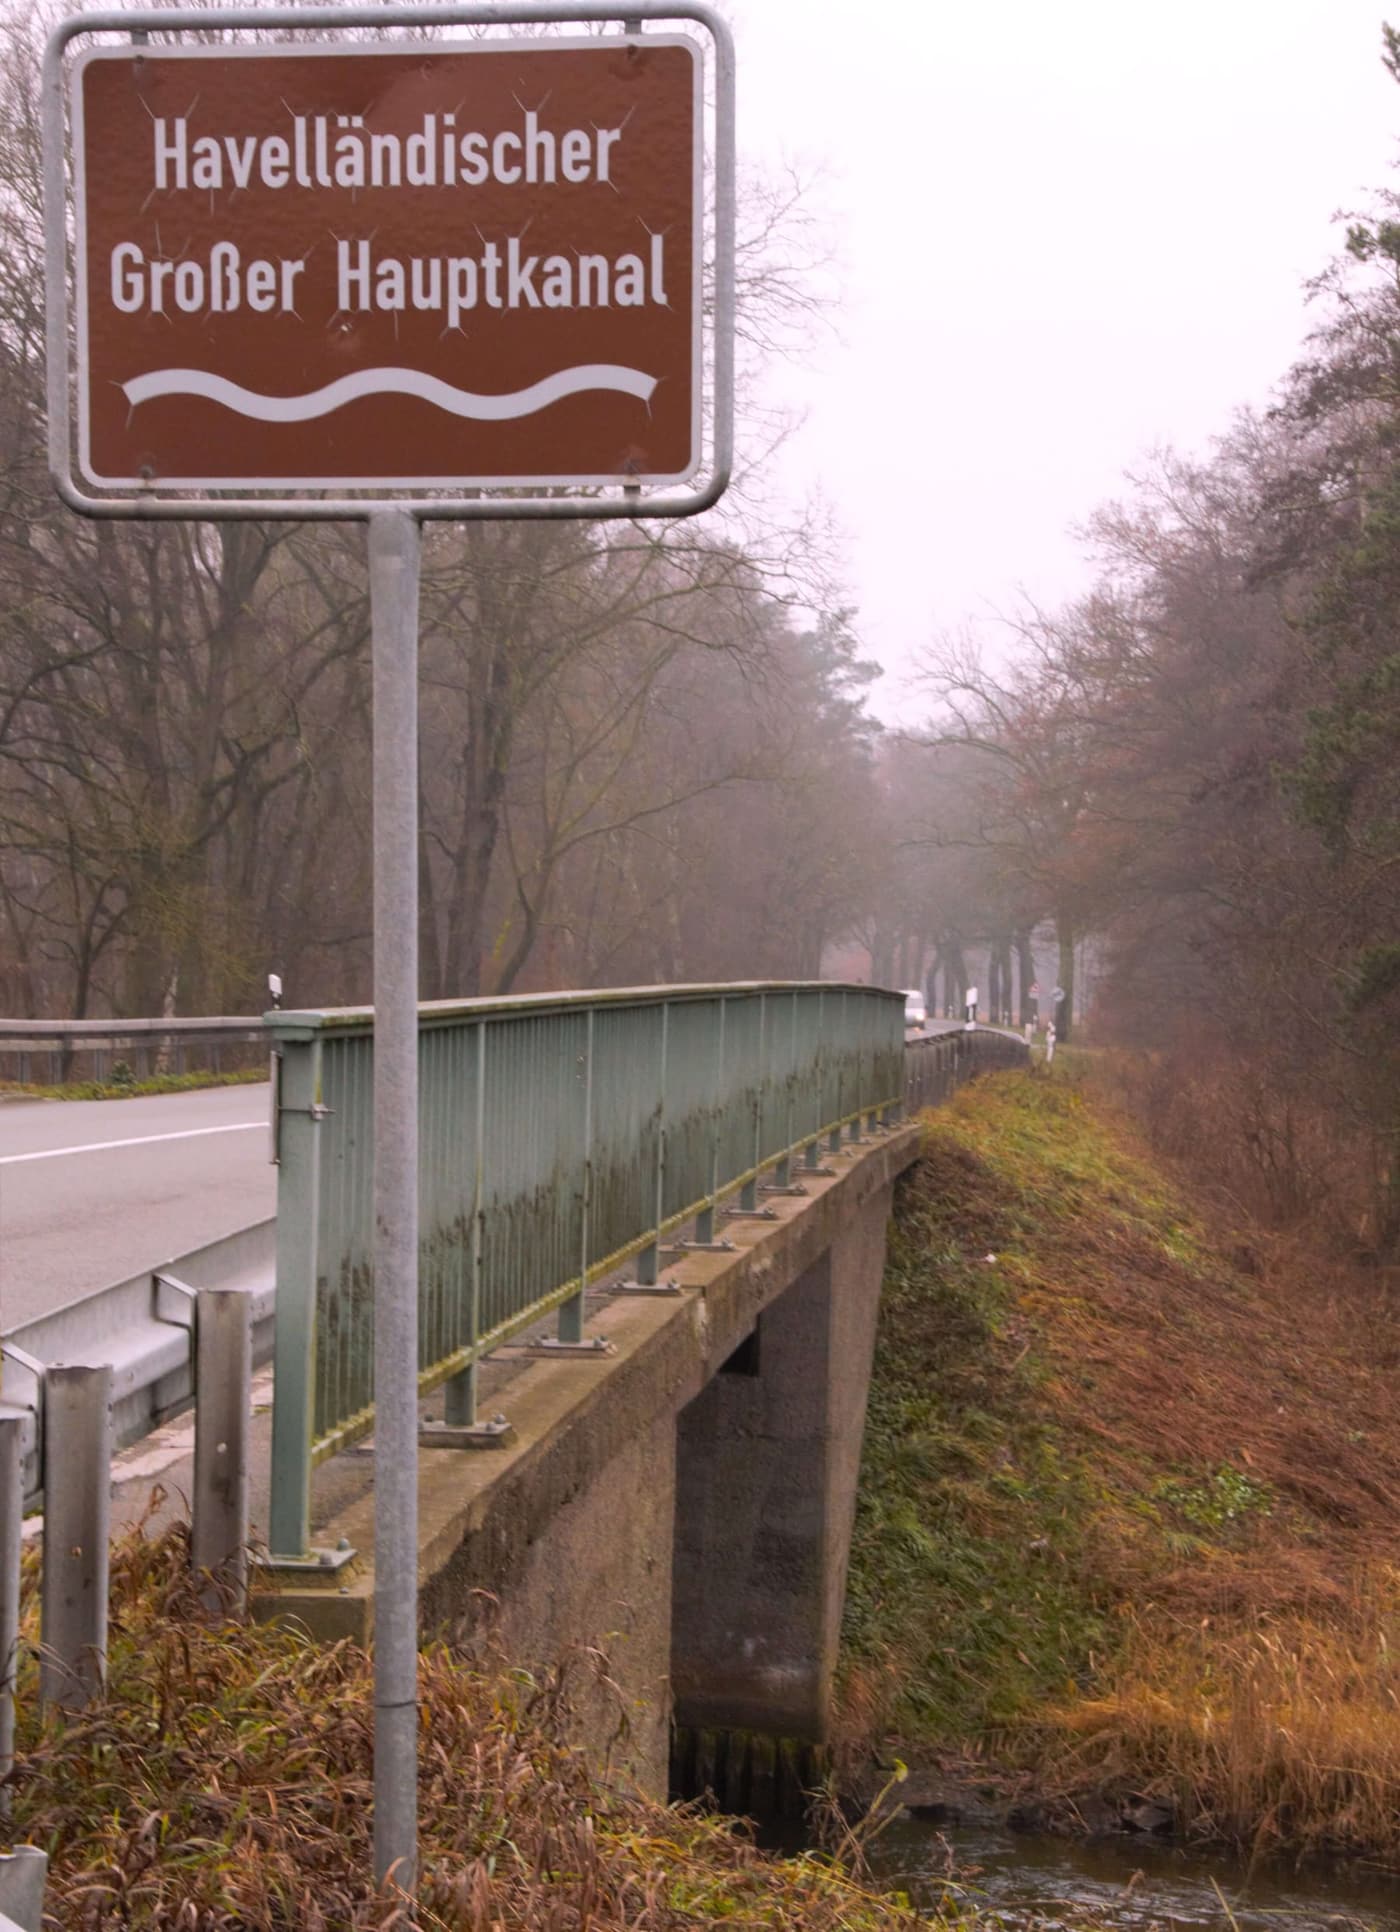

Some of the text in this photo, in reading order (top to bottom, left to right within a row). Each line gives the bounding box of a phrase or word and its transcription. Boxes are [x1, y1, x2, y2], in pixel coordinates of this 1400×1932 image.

[154, 111, 621, 189] Havelländischer
[111, 234, 667, 328] Großer Hauptkanal
